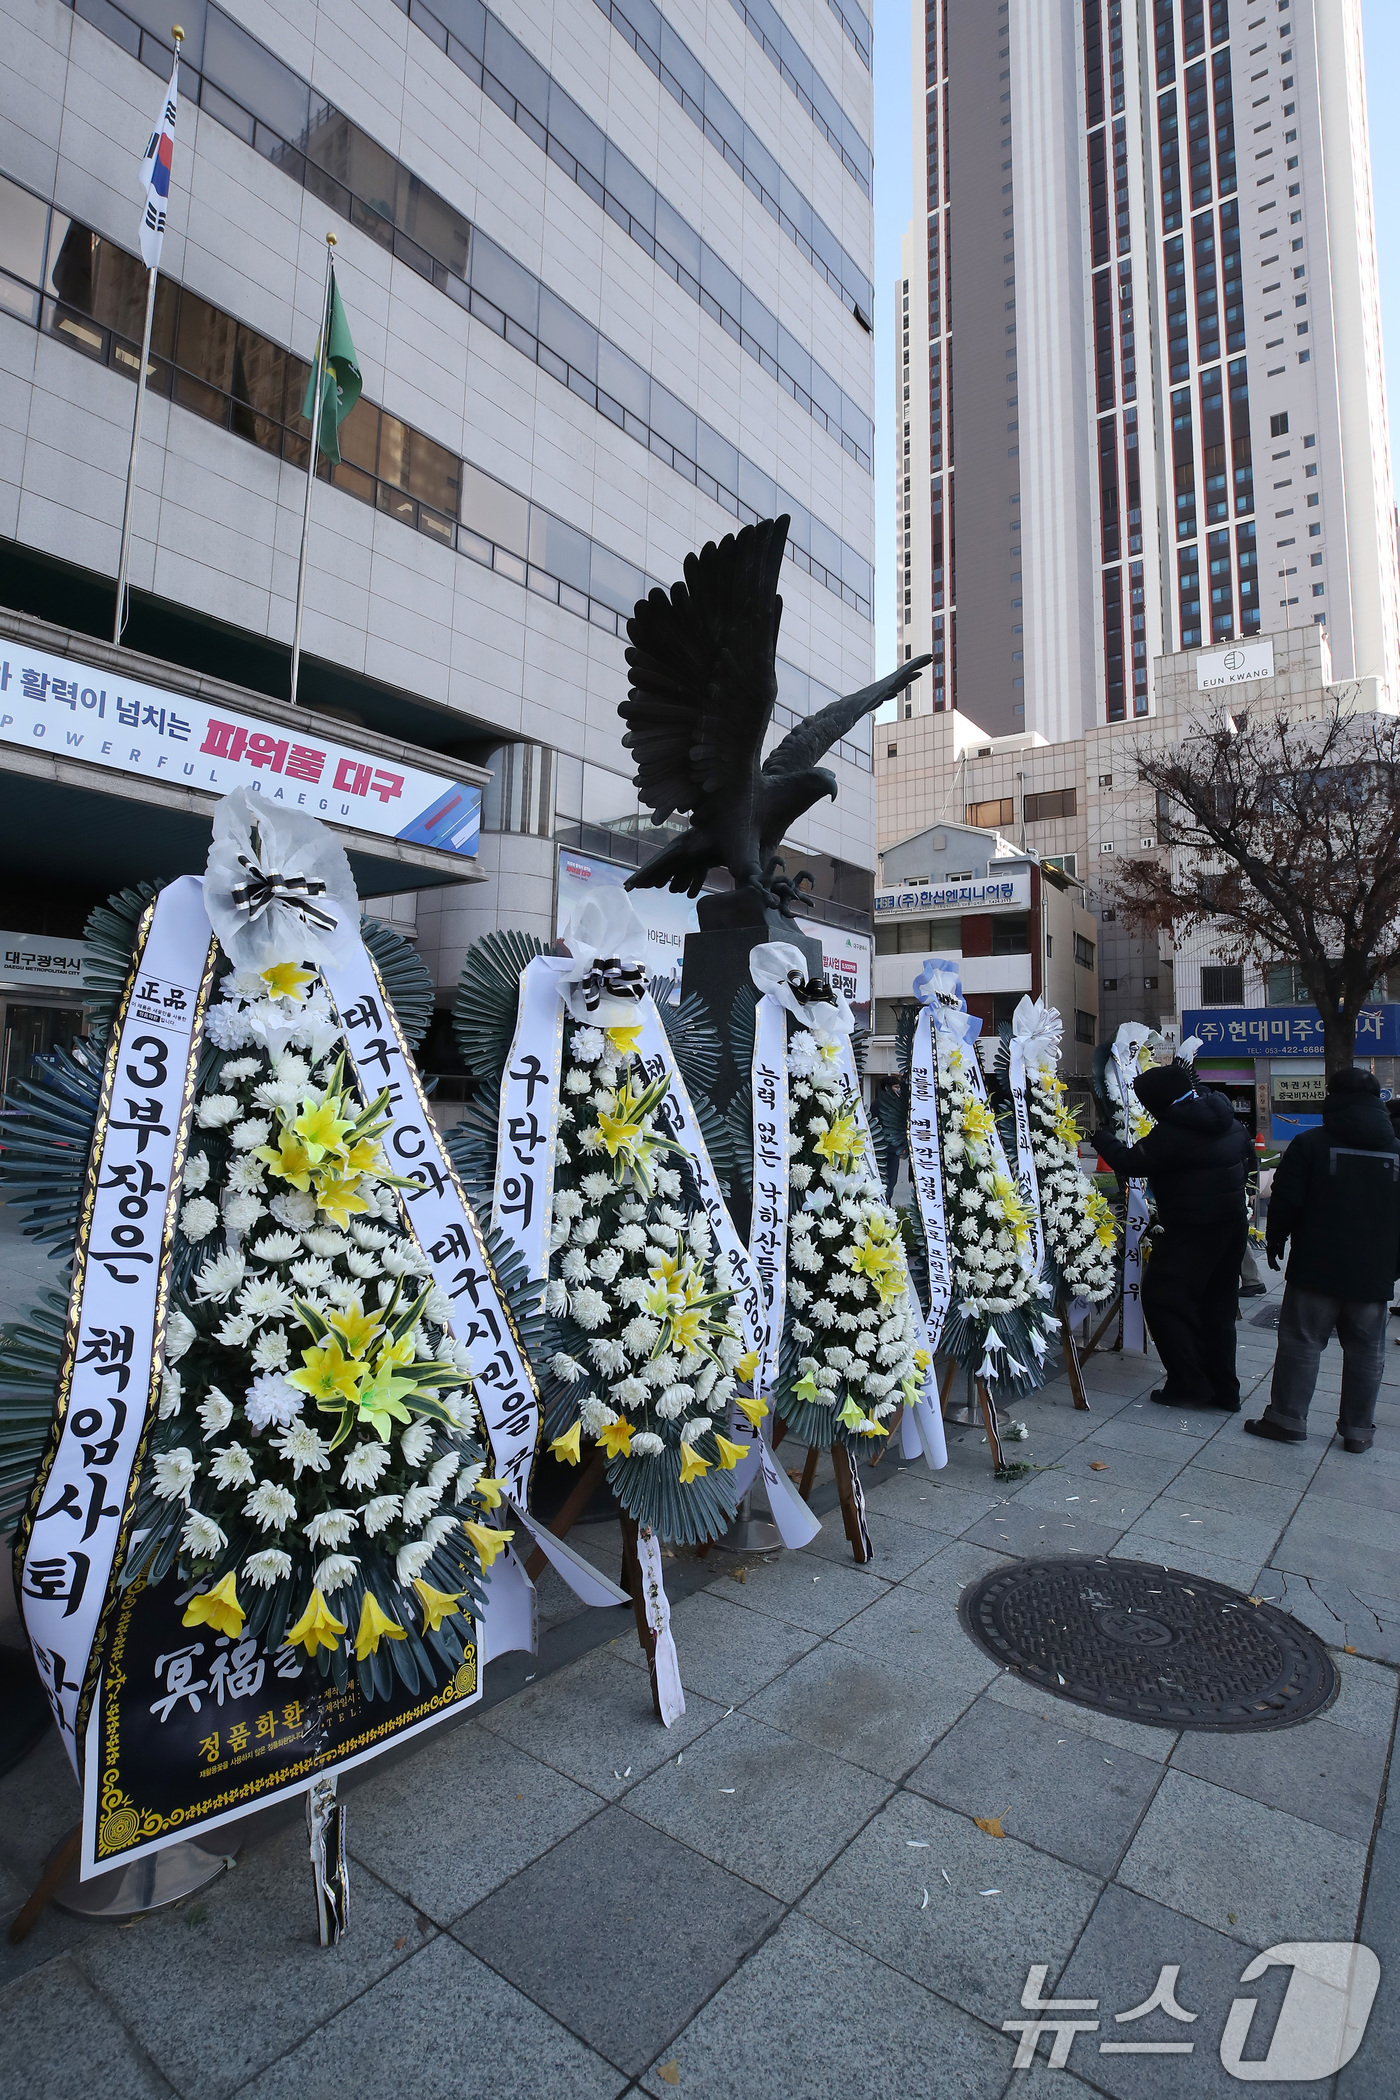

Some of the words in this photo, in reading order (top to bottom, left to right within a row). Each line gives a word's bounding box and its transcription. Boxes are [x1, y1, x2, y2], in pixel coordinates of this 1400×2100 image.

[1203, 677, 1225, 687] EUN
[1229, 668, 1269, 682] KWANG
[20, 668, 107, 719] 활력이
[116, 696, 192, 742] 넘치는
[199, 718, 327, 785] 파워풀
[332, 758, 405, 804] 대구
[0, 714, 218, 783] POWERFUL
[251, 780, 350, 816] DAEGU
[5, 951, 82, 971] 대구광역시
[25, 966, 68, 975] METROPOLITAN
[1264, 1046, 1325, 1054] 053-422-6686
[756, 1063, 781, 1111] 능력
[499, 1054, 549, 1231] 구단의
[757, 1122, 782, 1168] 없는
[427, 1223, 536, 1437] 대구시민을
[323, 1679, 355, 1699] 제작체
[324, 1692, 356, 1712] 제작일시
[198, 1700, 305, 1763] 정품화환
